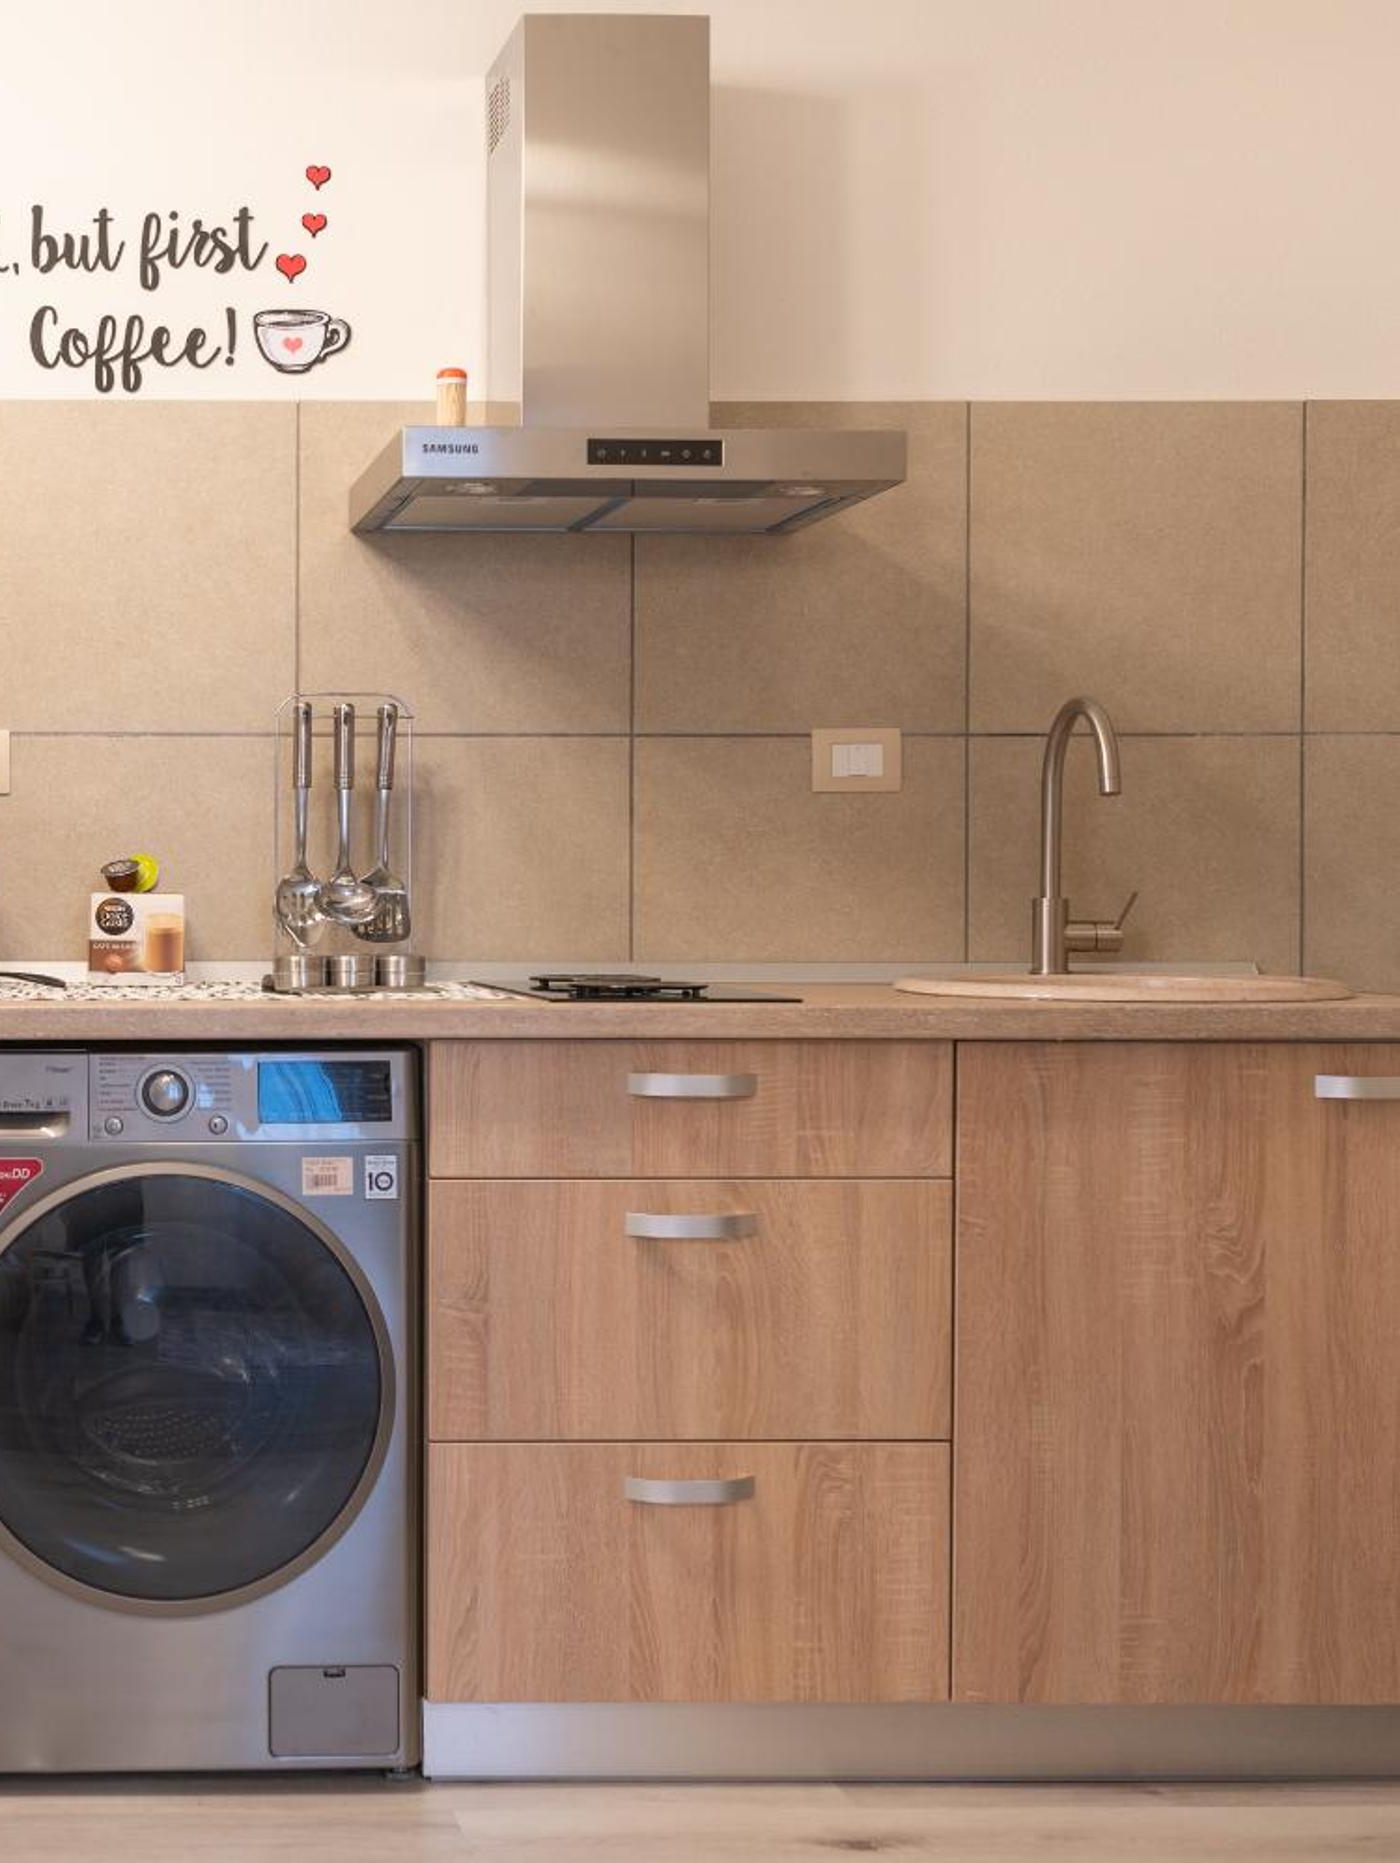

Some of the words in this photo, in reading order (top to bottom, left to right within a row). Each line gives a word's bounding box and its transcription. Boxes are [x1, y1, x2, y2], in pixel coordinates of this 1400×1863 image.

[31, 204, 125, 274] but
[139, 205, 269, 291] first
[29, 305, 237, 393] Coffee!
[422, 443, 479, 454] SAMSUNG
